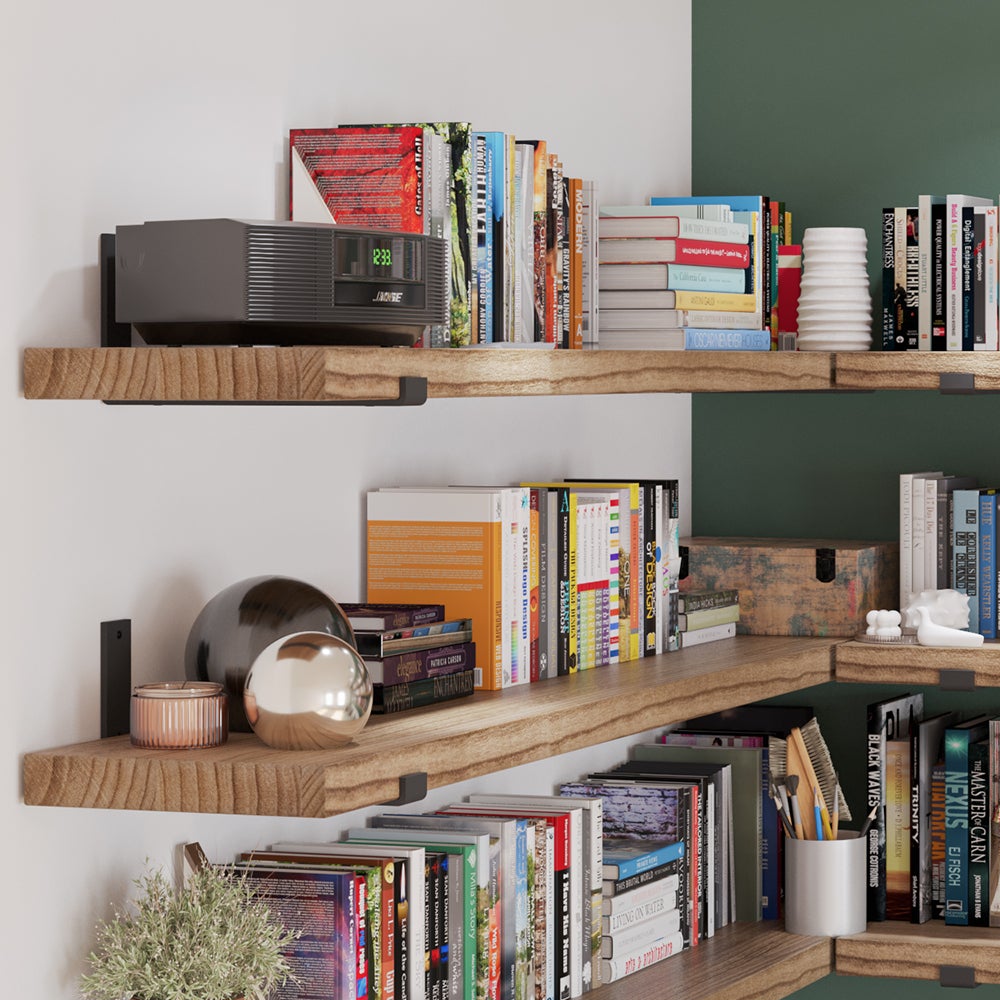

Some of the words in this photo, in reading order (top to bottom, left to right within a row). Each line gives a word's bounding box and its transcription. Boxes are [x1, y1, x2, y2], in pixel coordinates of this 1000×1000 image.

[415, 137, 423, 162] Hell
[415, 165, 423, 182] of
[415, 184, 423, 216] Gates
[884, 213, 894, 268] ENCHANTRESS
[396, 656, 423, 678] elegance
[431, 656, 448, 669] PATRICIA
[448, 653, 462, 665] CARSON
[868, 734, 880, 766] BLACK
[868, 771, 880, 807] WAVES
[945, 771, 968, 829] NEXUS
[469, 872, 477, 906] Mila's
[468, 909, 477, 939] Story
[400, 936, 407, 951] of
